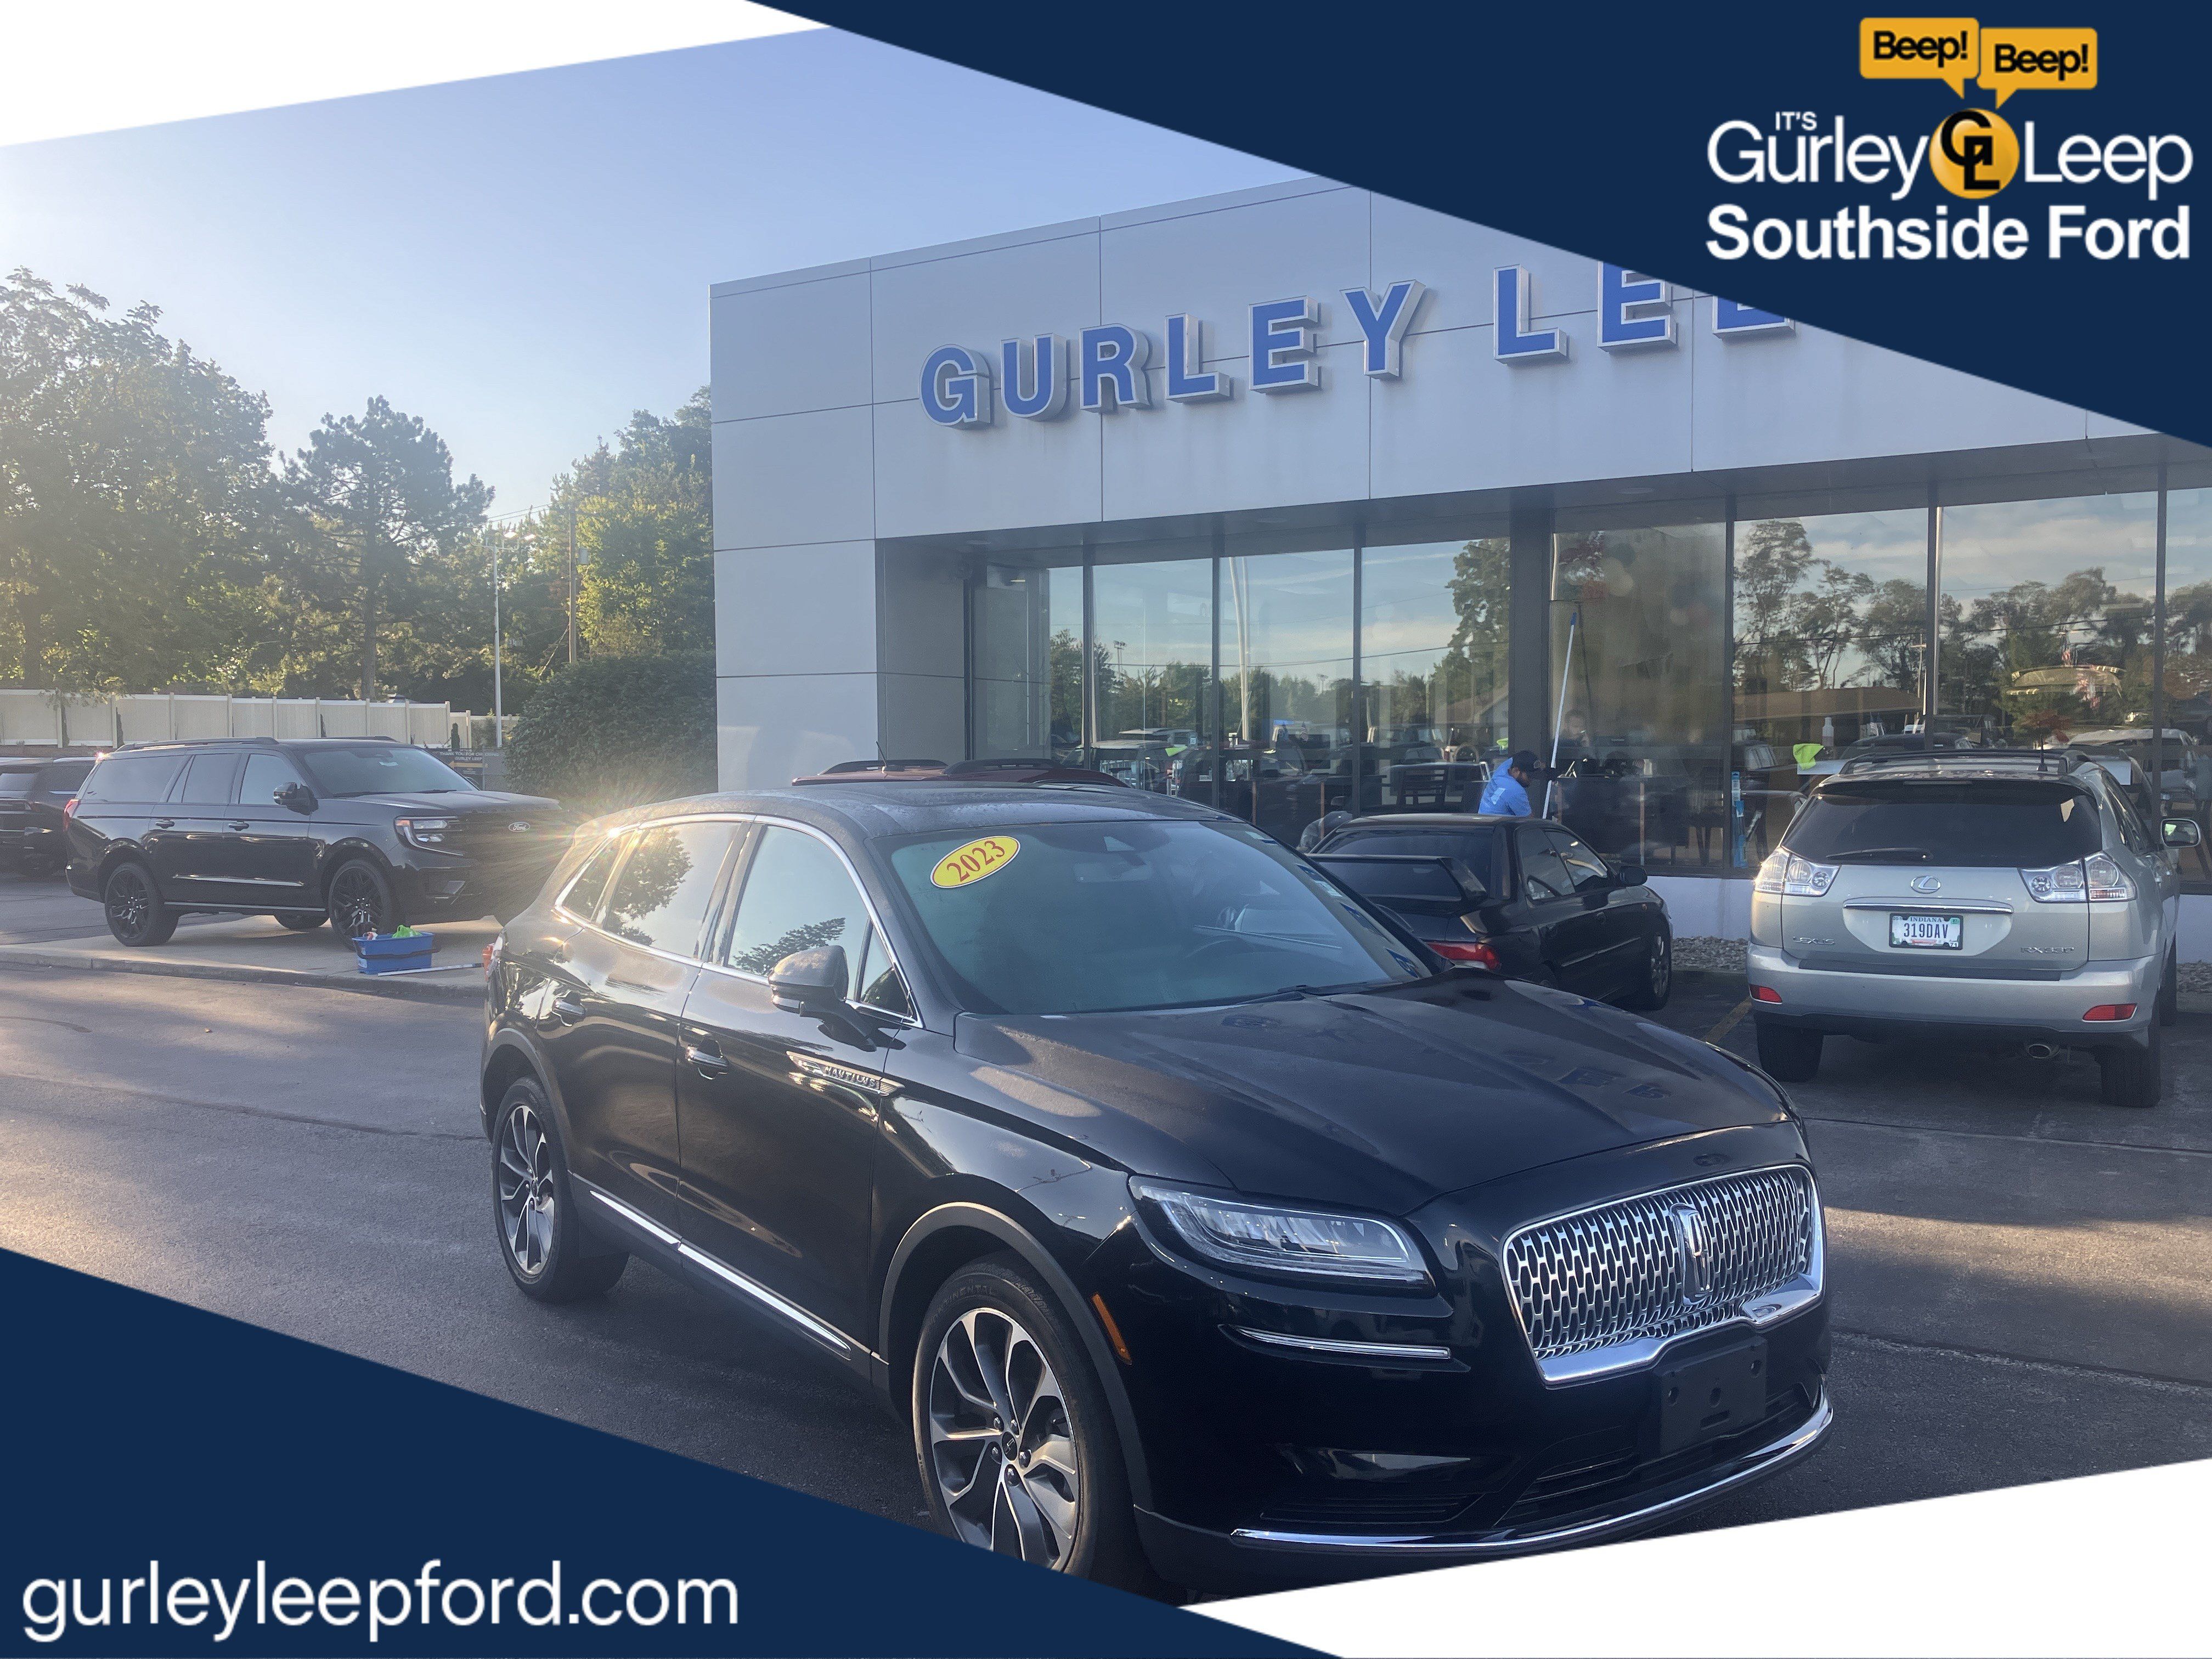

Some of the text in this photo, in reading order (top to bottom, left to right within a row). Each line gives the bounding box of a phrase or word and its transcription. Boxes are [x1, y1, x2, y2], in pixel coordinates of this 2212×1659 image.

[919, 280, 1422, 428] GURLEY
[946, 840, 1006, 883] 2023
[1792, 935, 1835, 945] LEXUS
[1903, 923, 1949, 939] 319DAV
[824, 1066, 876, 1087] NAUTILUS
